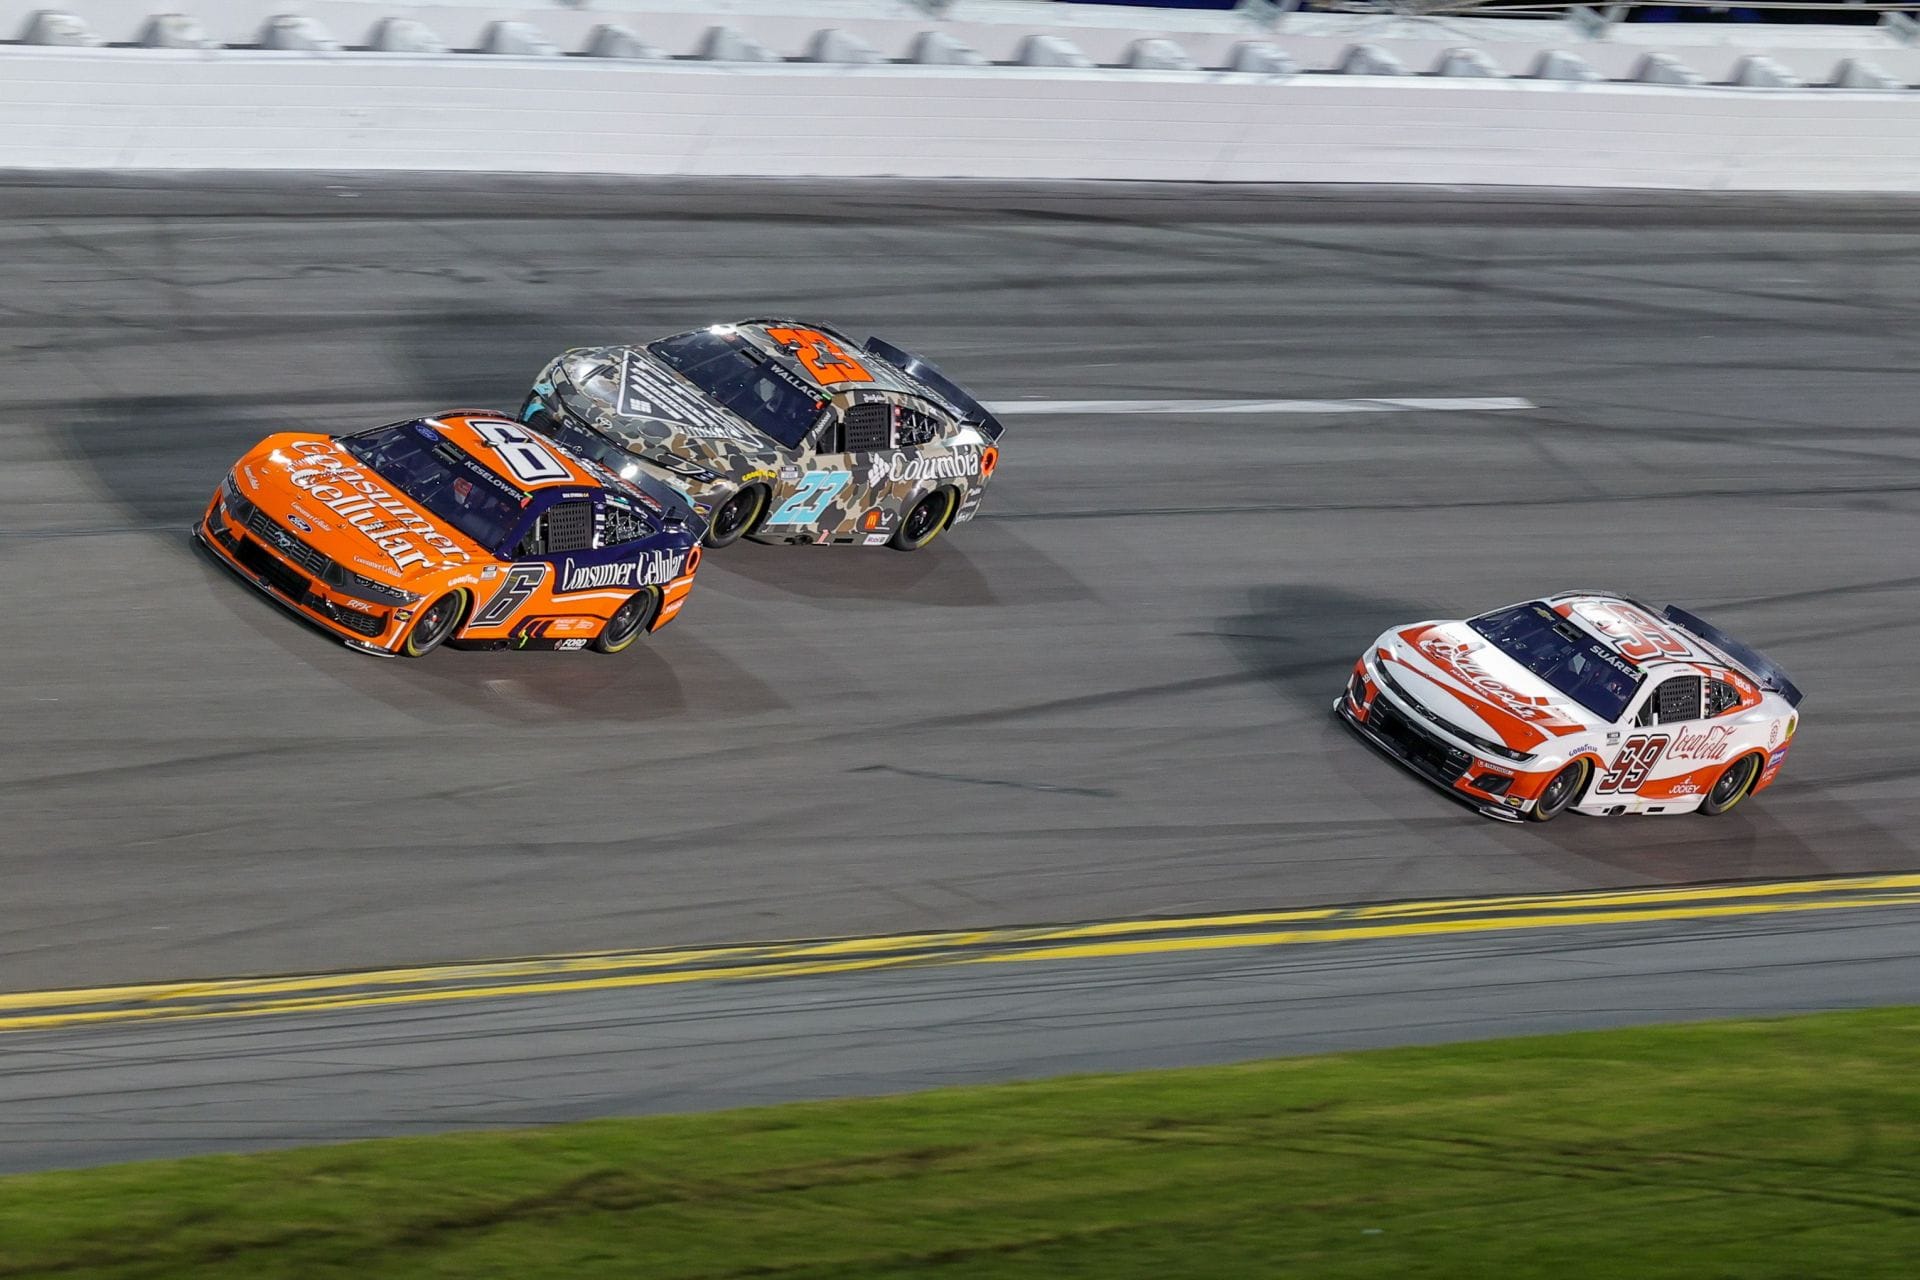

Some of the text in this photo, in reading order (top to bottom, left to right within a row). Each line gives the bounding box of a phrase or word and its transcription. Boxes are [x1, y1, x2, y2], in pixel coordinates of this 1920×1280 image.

[770, 363, 824, 403] WALLACE
[463, 460, 525, 501] KESELOWSK
[888, 451, 979, 483] Columbia
[291, 440, 471, 561] Consumer
[766, 470, 852, 525] 23
[290, 468, 437, 572] Cellular
[562, 550, 684, 591] Consumer Cellular
[468, 562, 547, 628] 6
[561, 639, 588, 647] FORD
[1590, 645, 1641, 683] SUÁREZ
[1595, 734, 1670, 795] 99
[1668, 785, 1700, 794] JOCKEY
